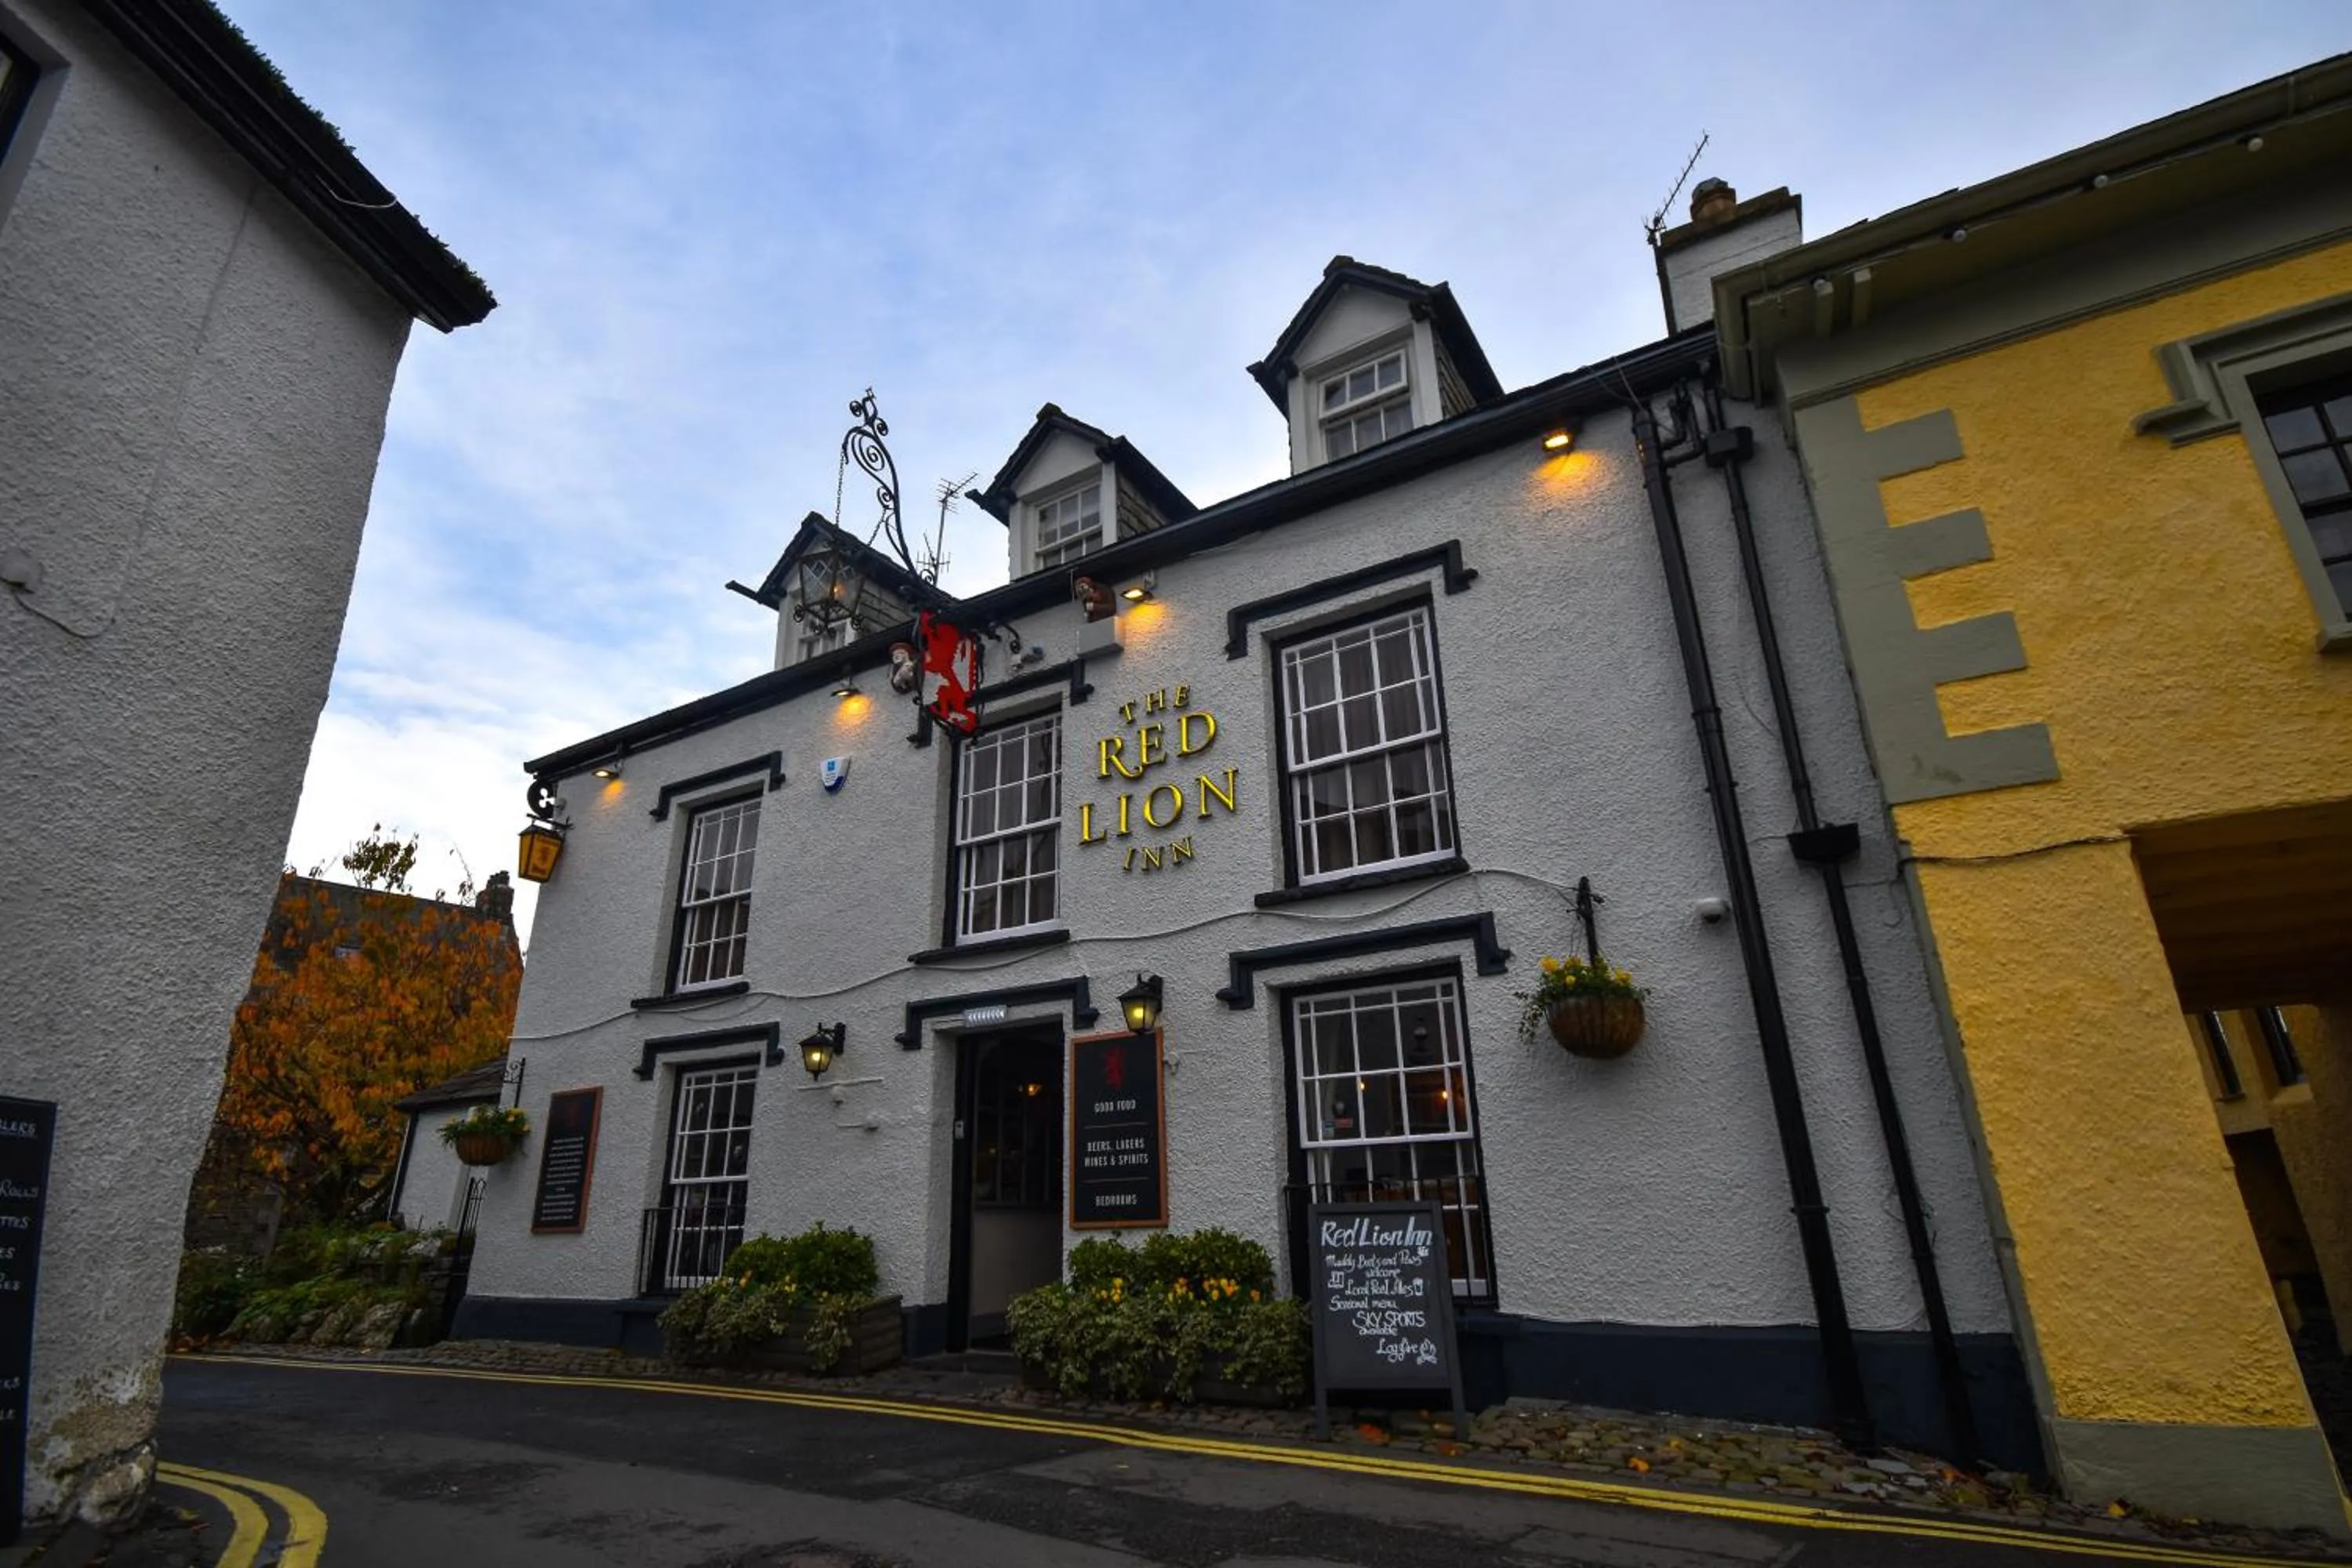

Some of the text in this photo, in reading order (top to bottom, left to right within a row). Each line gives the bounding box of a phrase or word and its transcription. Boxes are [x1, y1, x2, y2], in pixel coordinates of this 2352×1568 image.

[1119, 682, 1191, 724] THE
[1098, 710, 1217, 780] RED
[1079, 765, 1239, 845] LION
[1123, 836, 1194, 872] INN
[1094, 1099, 1136, 1112] GOOD FOOD
[1116, 1138, 1145, 1150] LAGERS
[1084, 1153, 1149, 1167] WINES & SPIRITS
[1095, 1194, 1138, 1207] BEDROOMS
[1321, 1216, 1432, 1247] Red Lion Inn
[1352, 1311, 1426, 1329] SKY SPORTS
